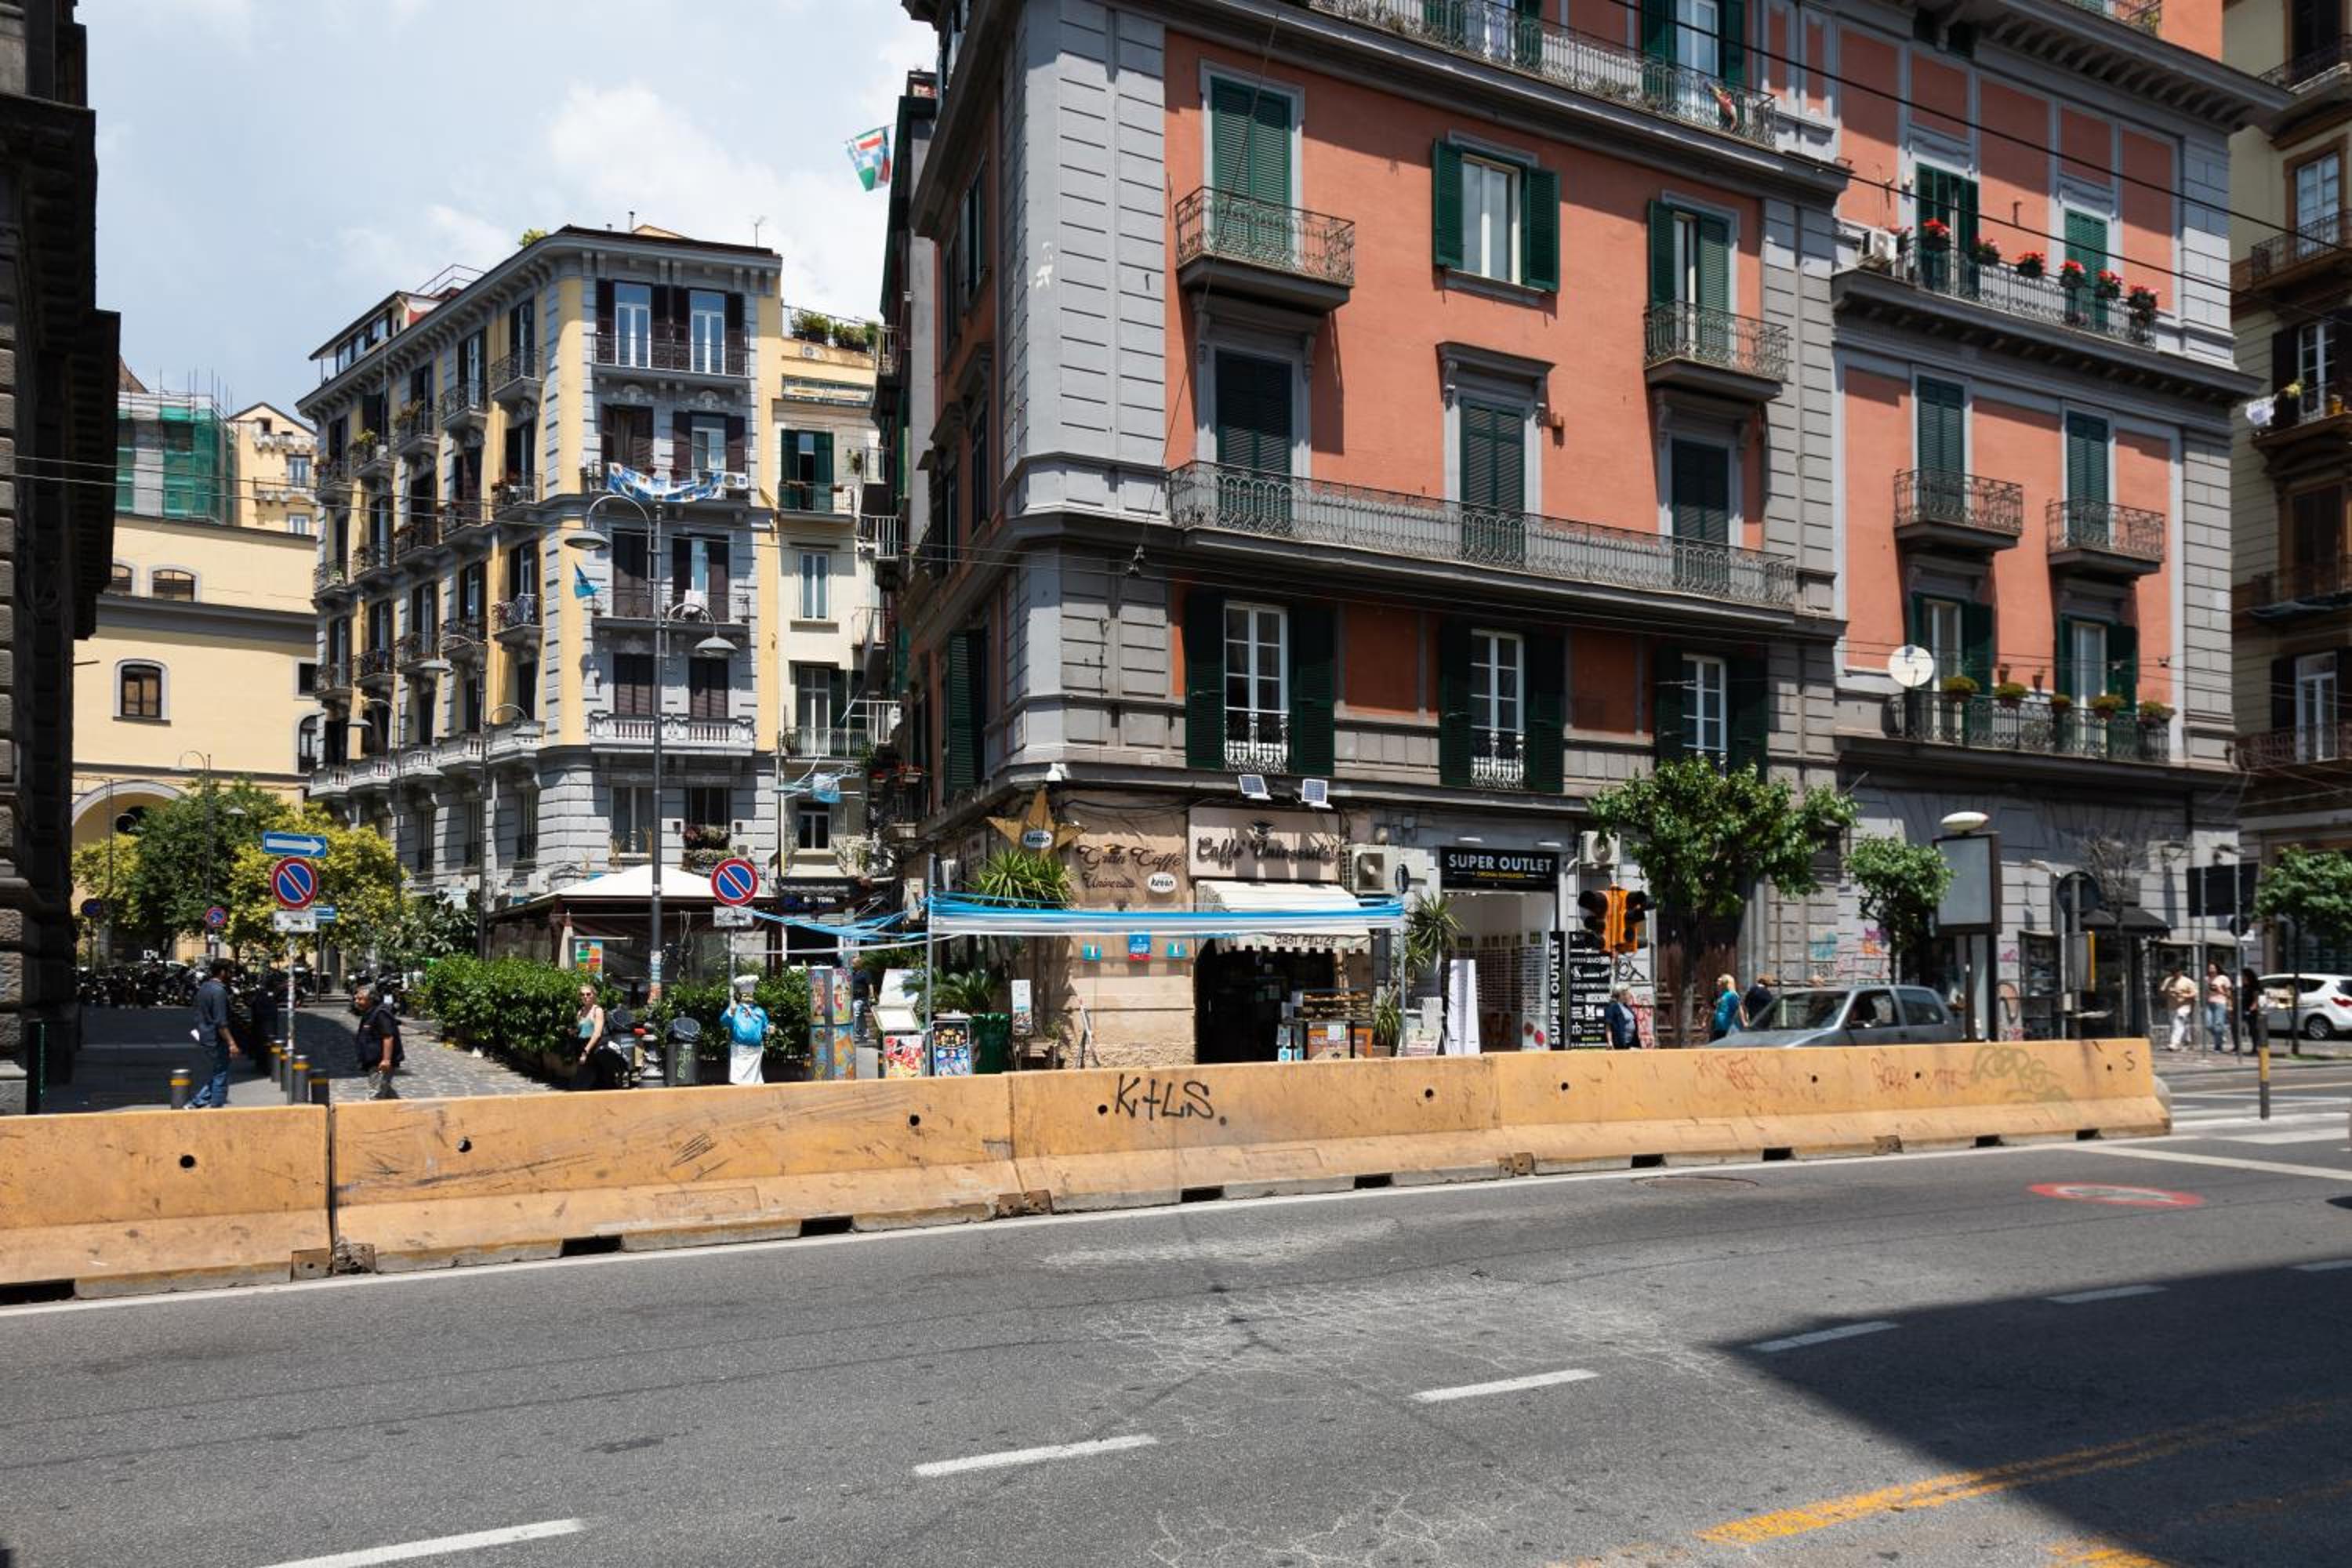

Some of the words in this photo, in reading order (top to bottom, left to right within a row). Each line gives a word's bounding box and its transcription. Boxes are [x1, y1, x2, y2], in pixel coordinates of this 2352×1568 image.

[1449, 854, 1494, 869] SUPER
[1498, 856, 1552, 873] OUTLET
[1550, 939, 1560, 994] OUTLET
[1550, 998, 1560, 1045] SUPER
